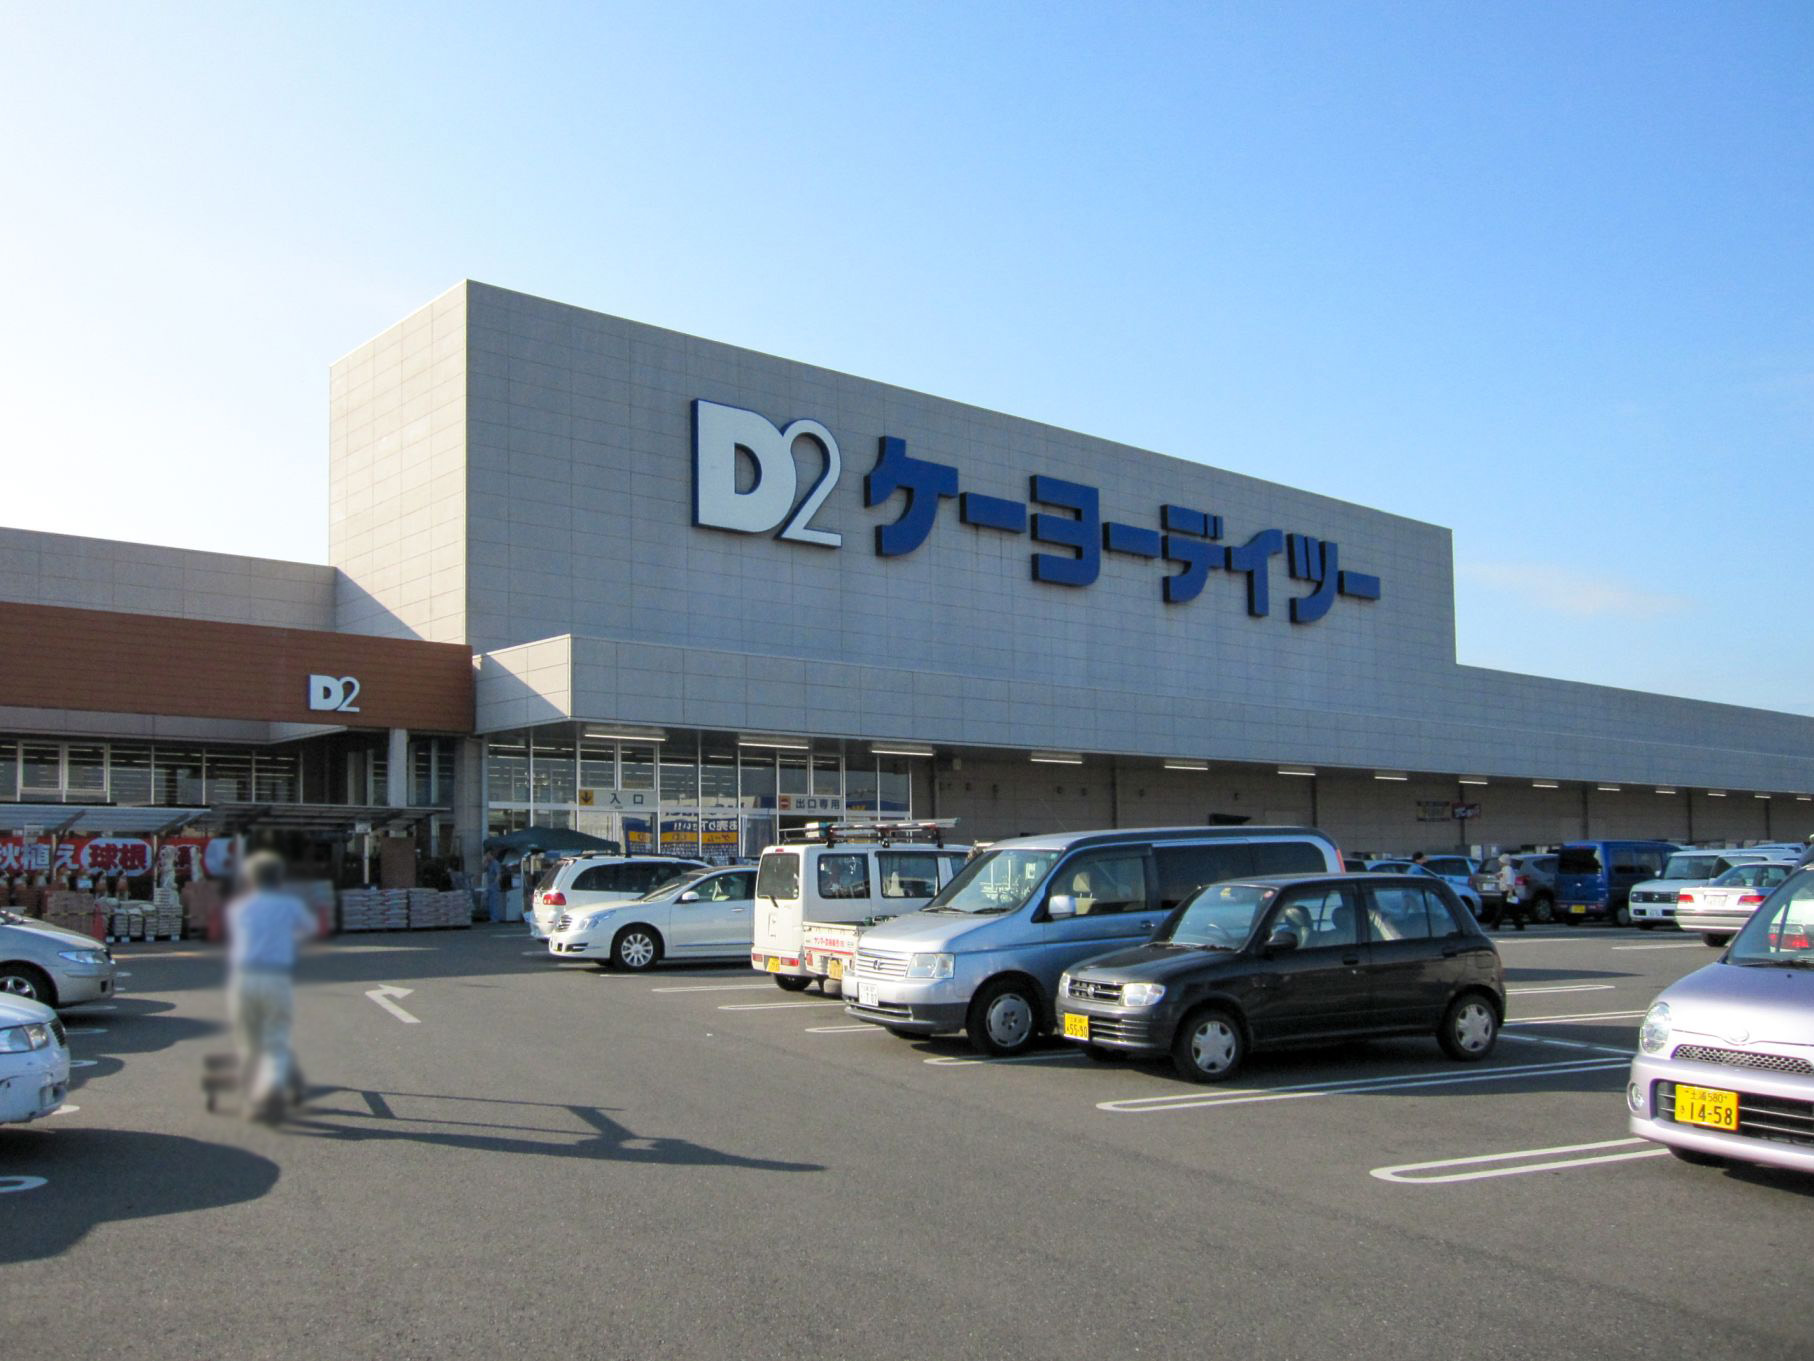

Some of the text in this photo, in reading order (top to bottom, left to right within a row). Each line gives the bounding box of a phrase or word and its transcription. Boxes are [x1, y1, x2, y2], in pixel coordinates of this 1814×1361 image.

[691, 398, 1380, 624] D2 ケーヨーデイツー
[307, 674, 361, 713] D2
[610, 792, 644, 805] 入口
[796, 798, 840, 810] 出口専用
[1690, 1102, 1733, 1126] 14-58
